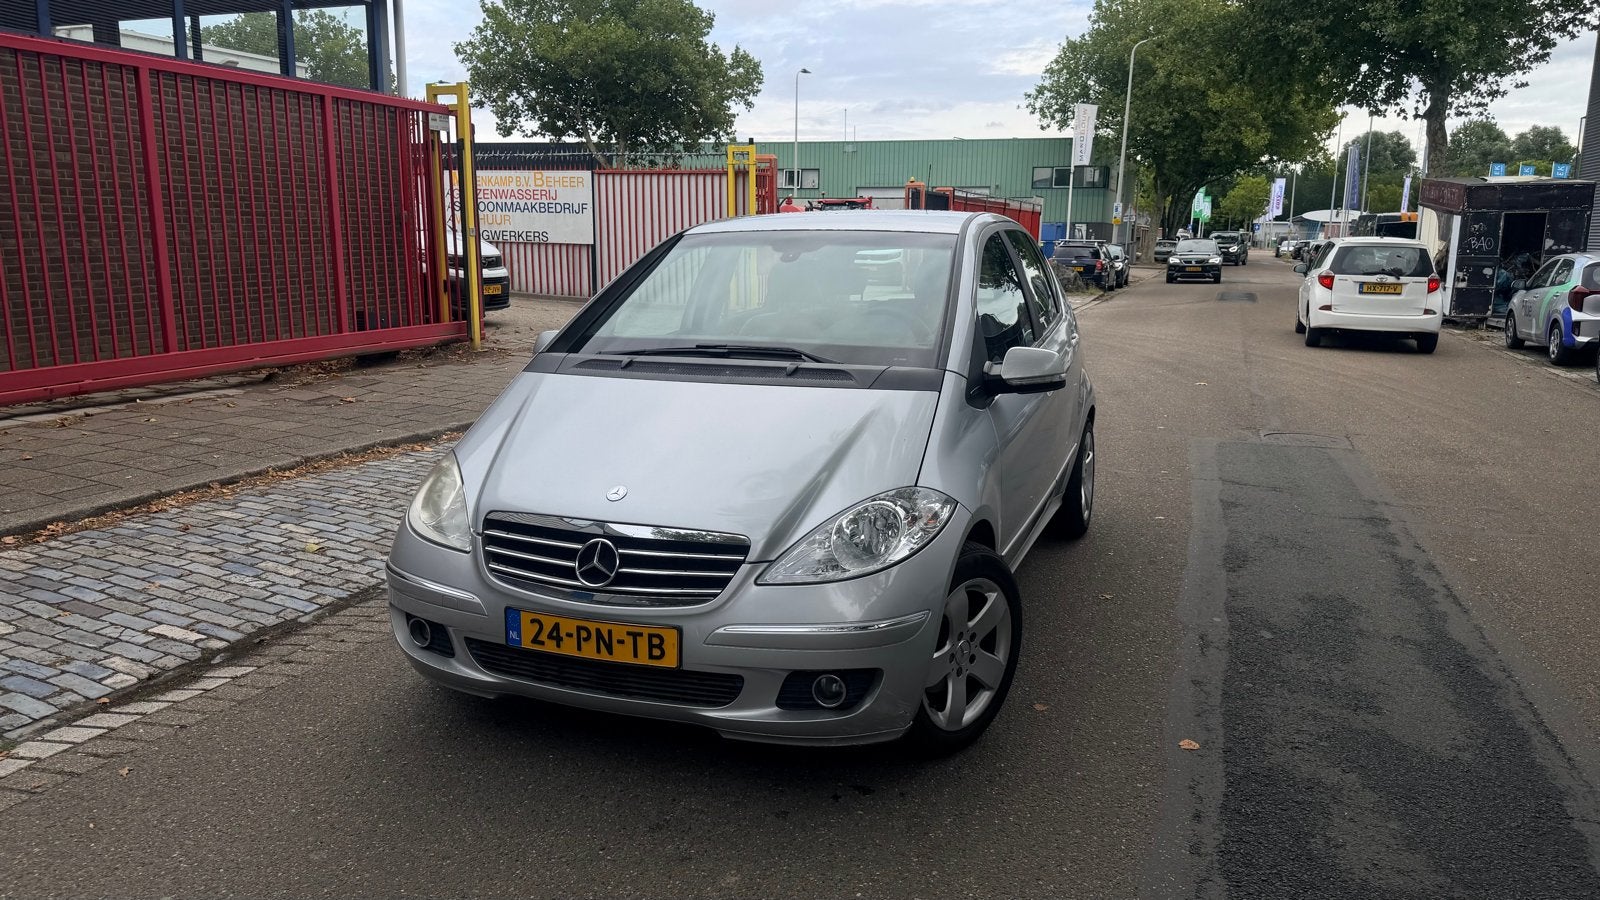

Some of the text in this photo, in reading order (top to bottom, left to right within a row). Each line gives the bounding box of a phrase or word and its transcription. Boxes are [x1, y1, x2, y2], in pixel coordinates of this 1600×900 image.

[515, 175, 531, 187] B.V.
[453, 188, 557, 201] GZENWASSERIJ
[454, 201, 588, 214] SOONMAAKBEDRIJF
[481, 230, 549, 242] GWERKERS
[1366, 285, 1398, 293] HX-717-V
[509, 617, 666, 661] NL 24-PN-TB
